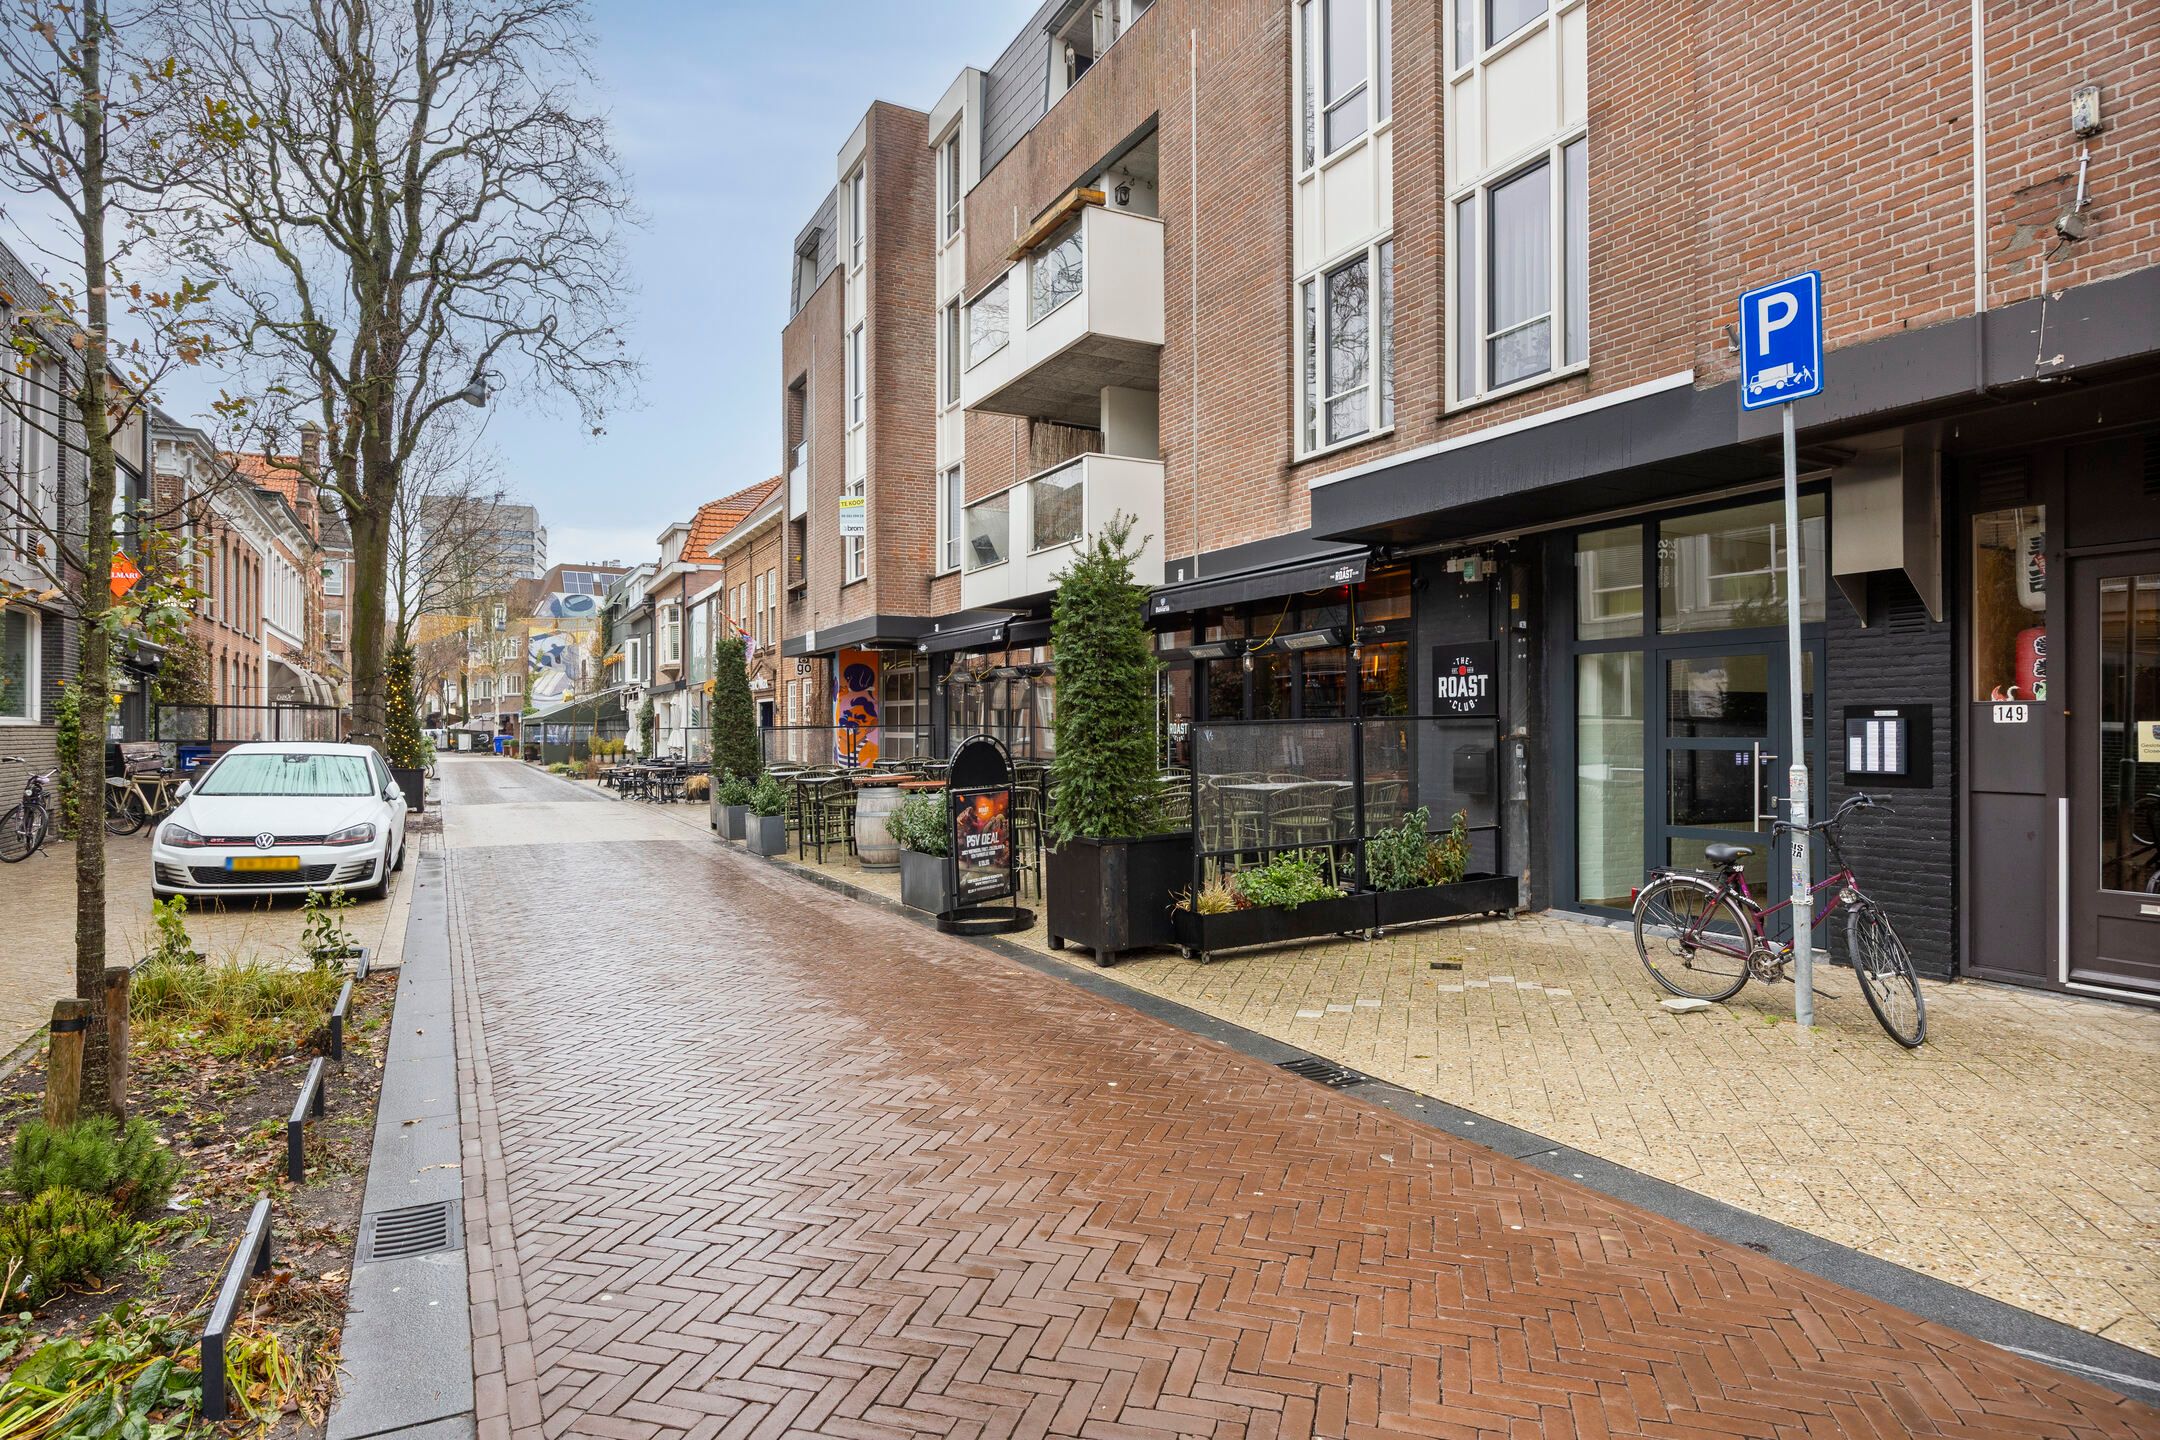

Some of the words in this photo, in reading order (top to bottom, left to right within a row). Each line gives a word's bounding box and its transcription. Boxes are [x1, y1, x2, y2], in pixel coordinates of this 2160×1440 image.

[1758, 291, 1799, 356] P
[1456, 656, 1470, 665] THE
[1438, 674, 1489, 698] ROAST
[1451, 699, 1476, 712] CLUB
[1998, 706, 2024, 721] 149
[1169, 722, 1189, 735] ROAST
[966, 833, 980, 848] PSV
[981, 831, 1000, 846] DEAL
